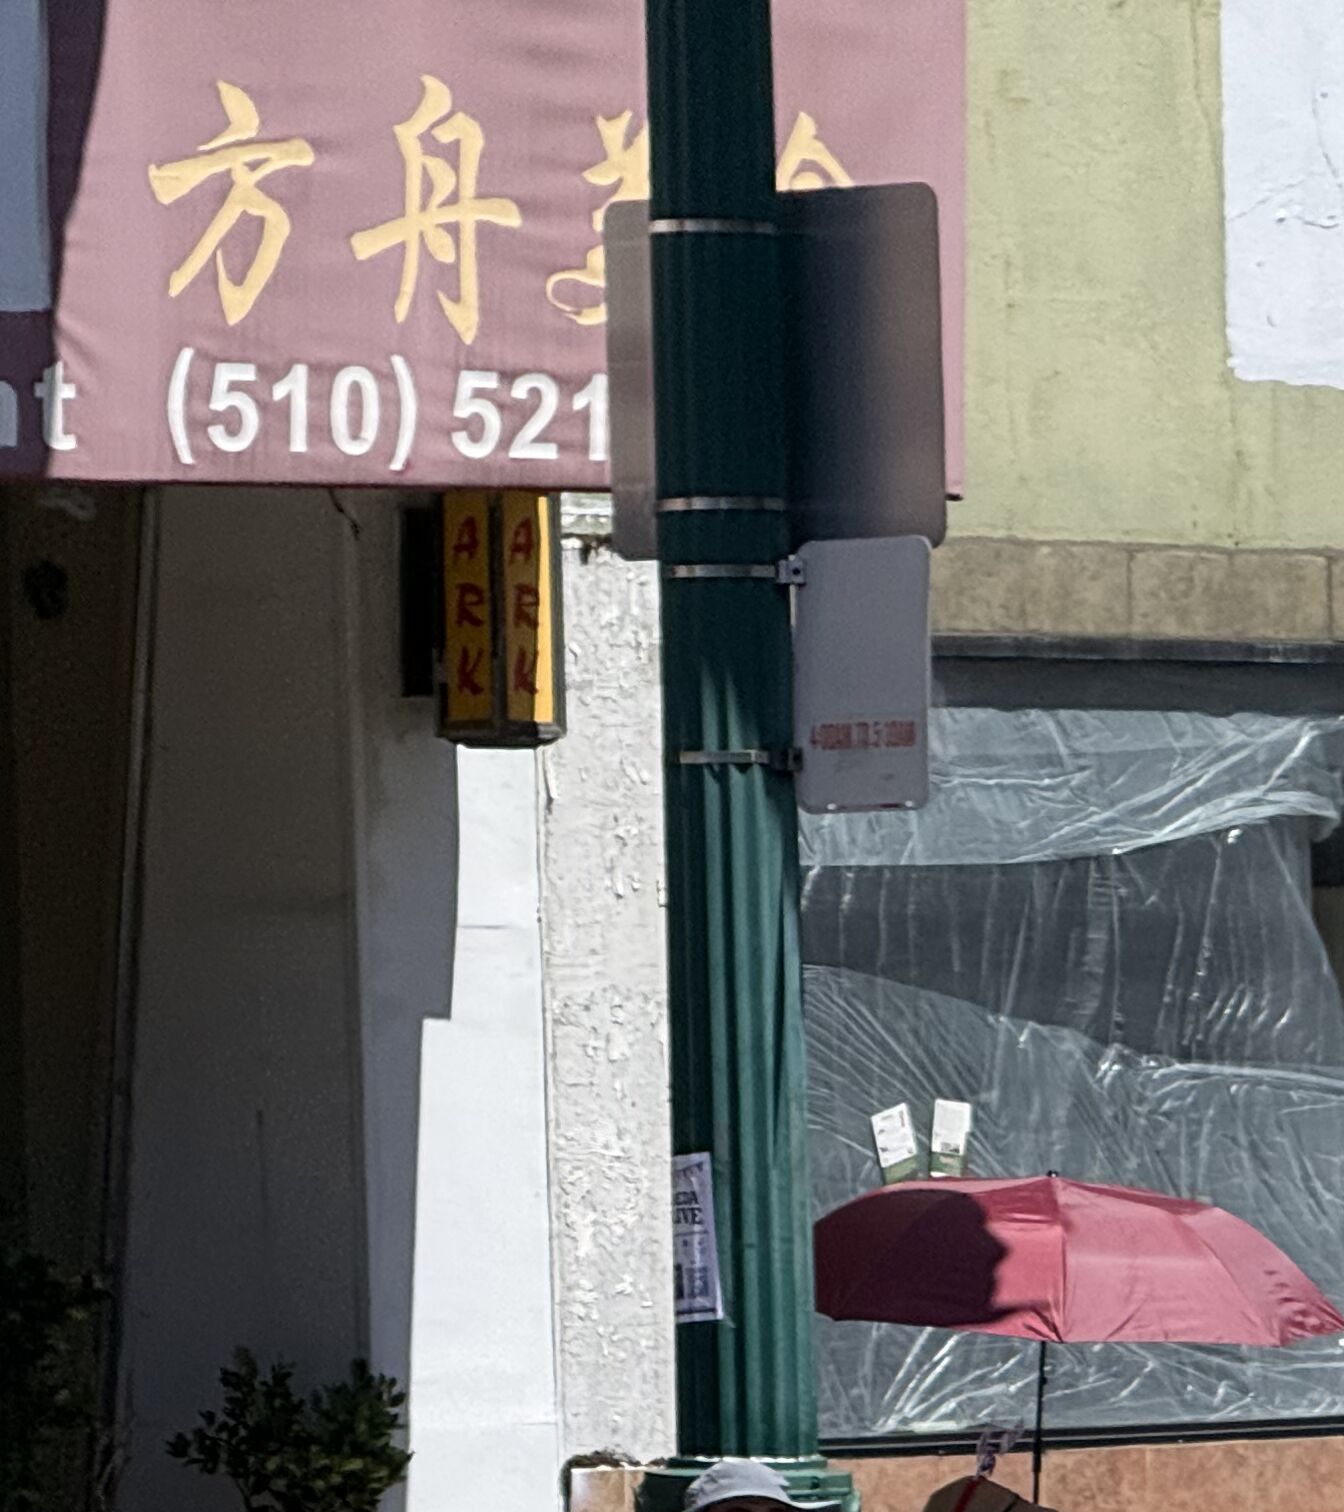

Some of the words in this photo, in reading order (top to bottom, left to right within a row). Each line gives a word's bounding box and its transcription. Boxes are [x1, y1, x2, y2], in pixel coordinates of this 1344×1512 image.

[166, 347, 417, 471] (510)
[450, 369, 610, 462] 521
[452, 515, 485, 696] ARK
[509, 516, 540, 696] ARK
